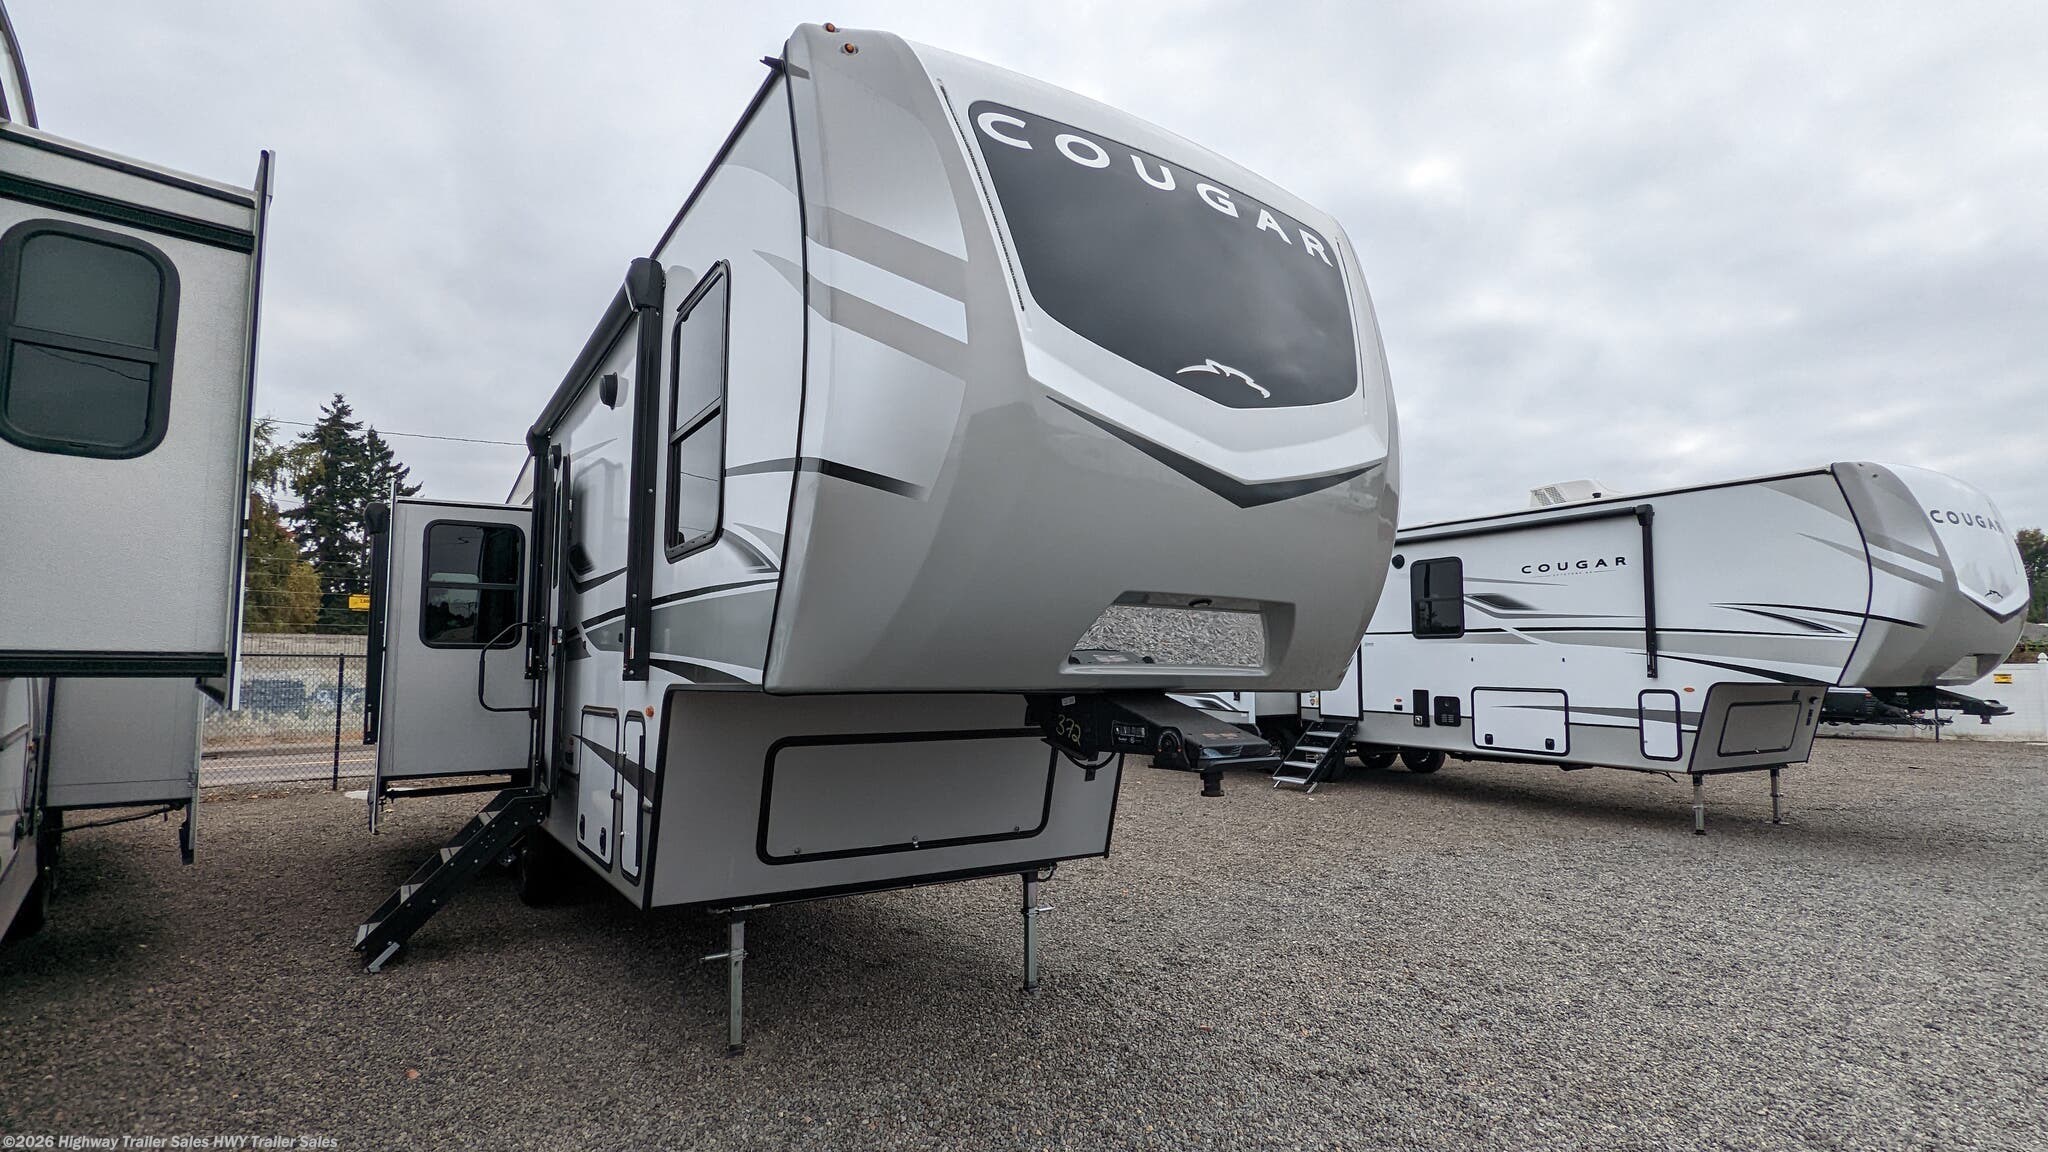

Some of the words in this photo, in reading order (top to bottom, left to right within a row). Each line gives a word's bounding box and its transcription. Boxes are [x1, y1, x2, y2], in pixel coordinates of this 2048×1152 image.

[977, 112, 1334, 267] COUGAR
[1521, 556, 1627, 574] COUGAR
[1056, 714, 1081, 746] 372
